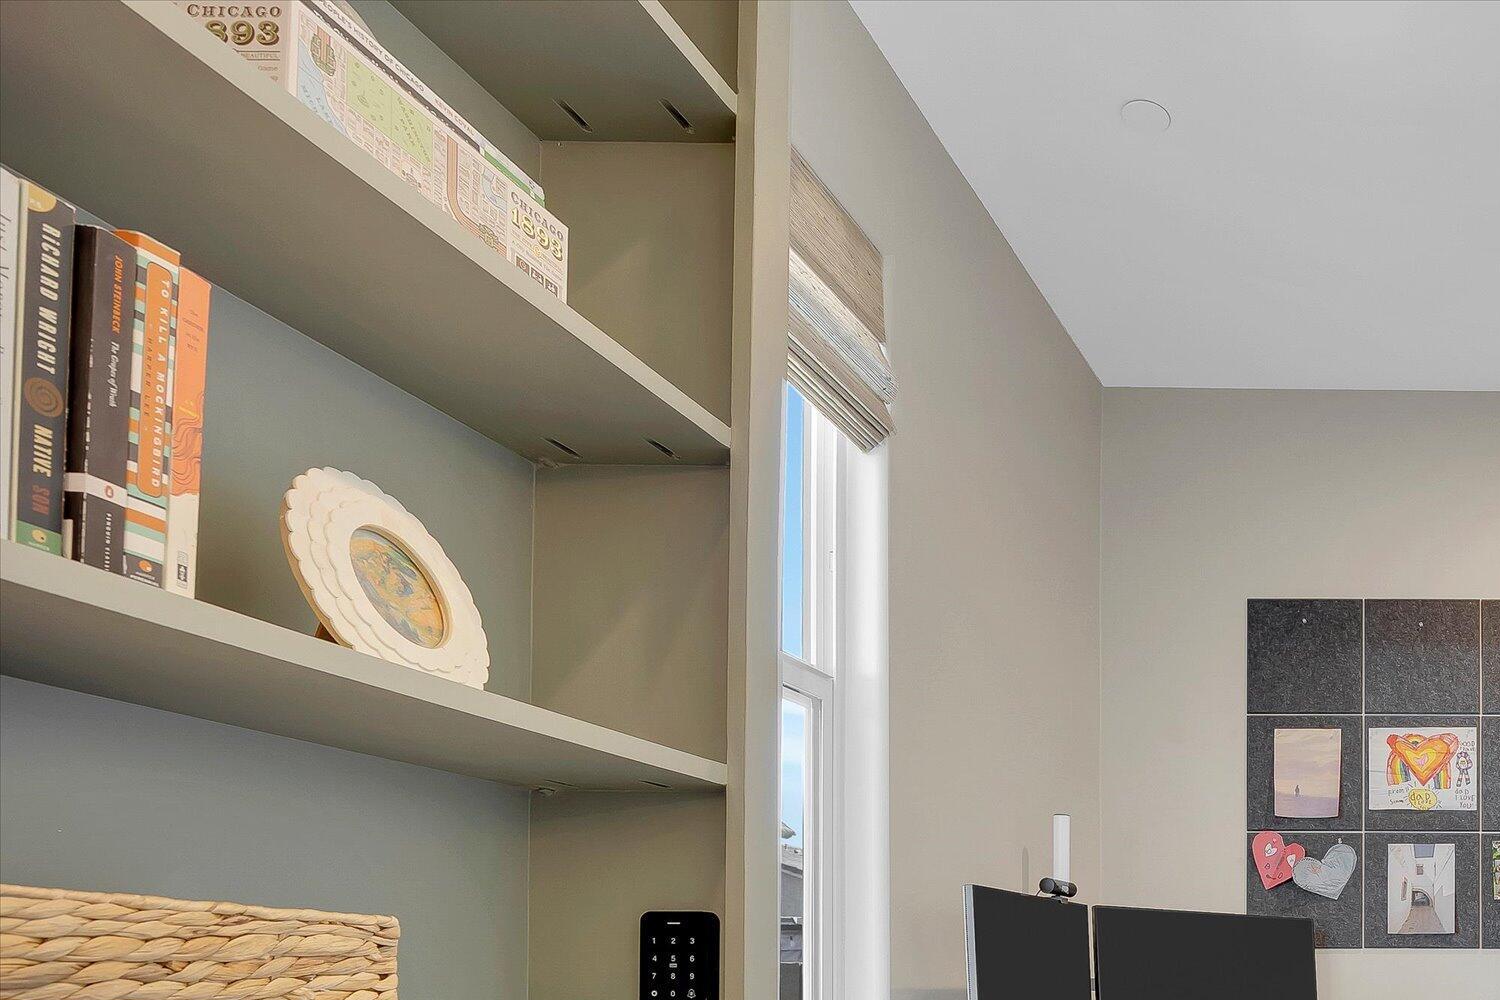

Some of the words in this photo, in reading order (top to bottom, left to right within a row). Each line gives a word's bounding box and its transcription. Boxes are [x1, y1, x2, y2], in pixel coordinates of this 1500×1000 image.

[187, 4, 282, 18] CHICAGO
[205, 20, 280, 45] 893
[394, 61, 425, 92] CHICAGO
[511, 192, 564, 240] CHICAGO
[510, 207, 564, 262] 1893
[114, 255, 124, 282] JOHN
[161, 279, 171, 298] TO
[112, 283, 124, 335] STEINBECK
[158, 306, 169, 344] KILL
[36, 306, 58, 375] WRIGHT
[111, 341, 120, 356] The
[156, 354, 165, 363] A
[151, 371, 166, 488] MOCKINGBIRD
[32, 424, 53, 478] NATIVE
[31, 484, 50, 515] SON
[651, 937, 656, 945] 1
[670, 937, 677, 945] 2
[689, 937, 696, 945] 3
[651, 955, 658, 963] 4
[670, 955, 677, 963] 5
[689, 955, 696, 963] 6
[651, 973, 658, 981] 7
[670, 973, 677, 981] 8
[689, 973, 696, 981] 9
[669, 990, 676, 998] 0
